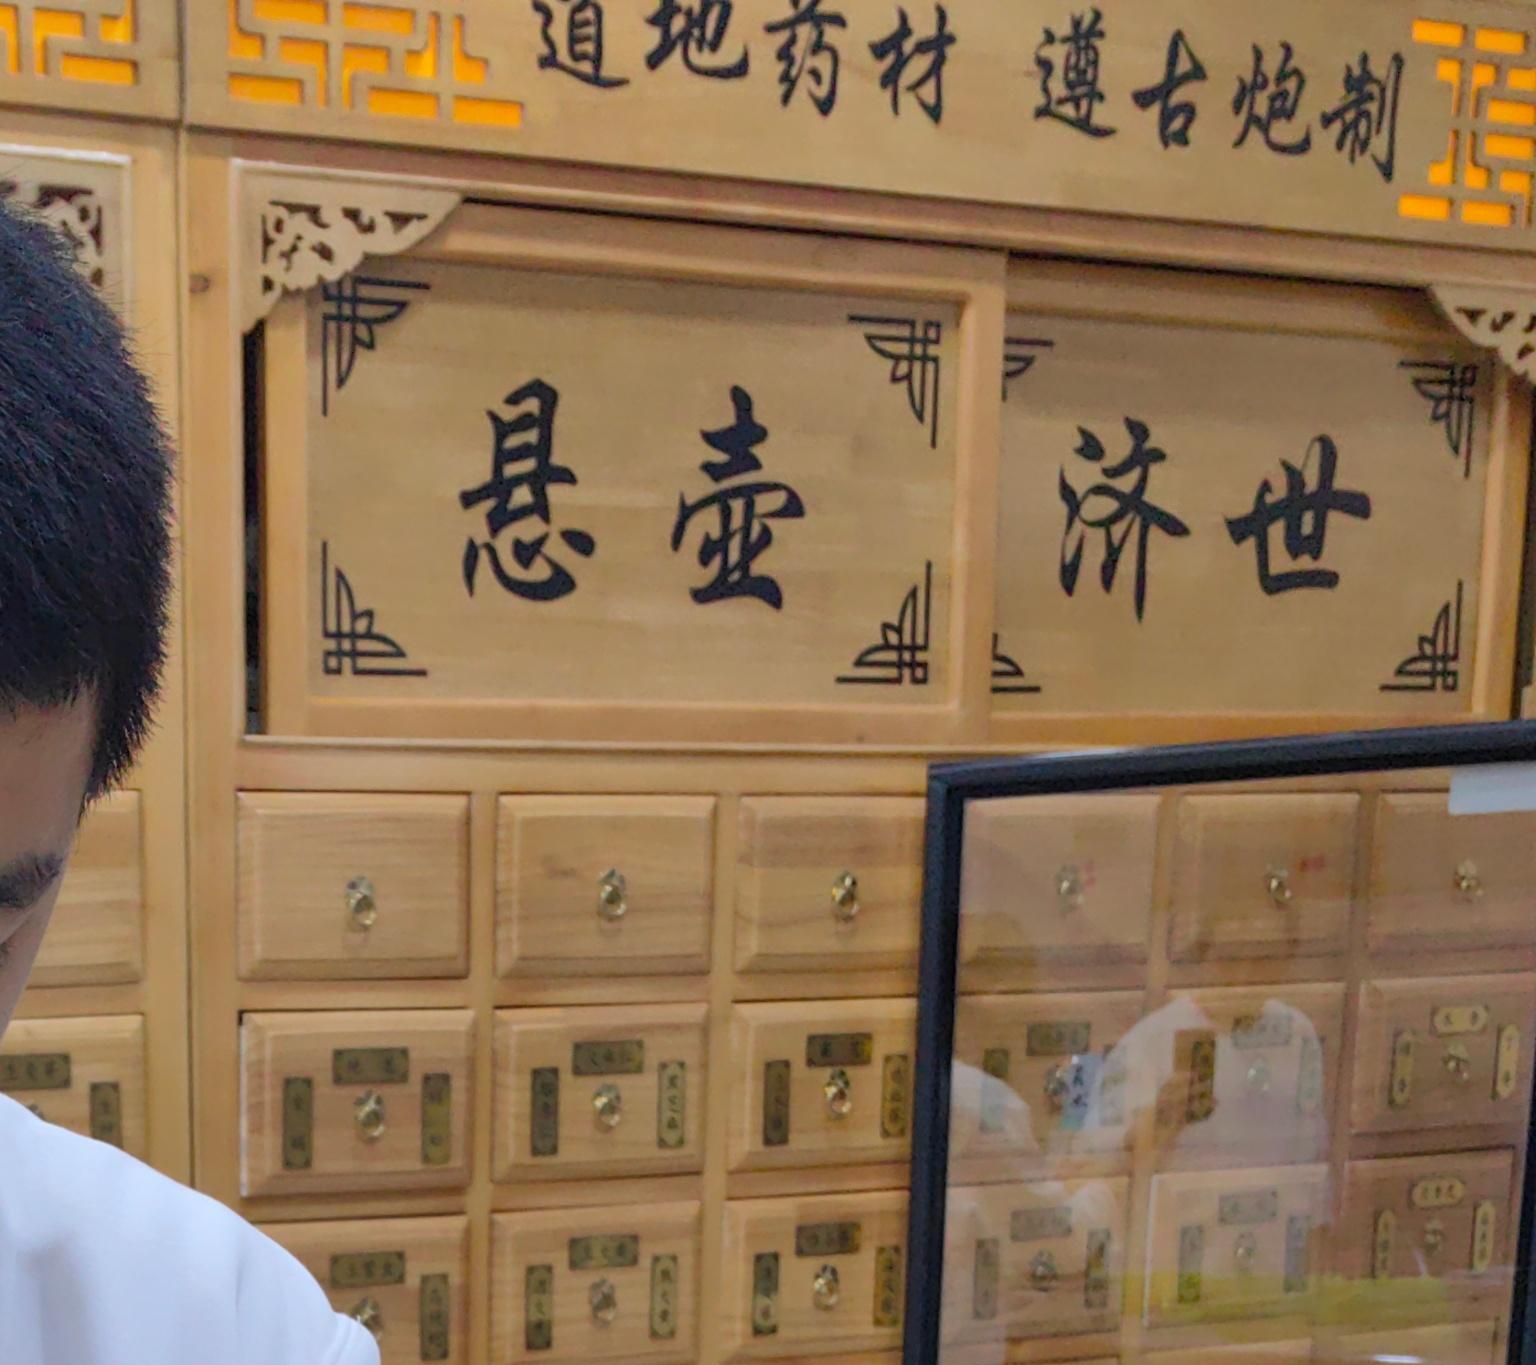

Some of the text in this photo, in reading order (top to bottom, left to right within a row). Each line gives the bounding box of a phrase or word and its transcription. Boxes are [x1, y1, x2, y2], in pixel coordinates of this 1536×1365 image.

[1034, 13, 1405, 183] 遵古炮制
[459, 377, 805, 610] 悬壶
[1059, 417, 1372, 620] 济世
